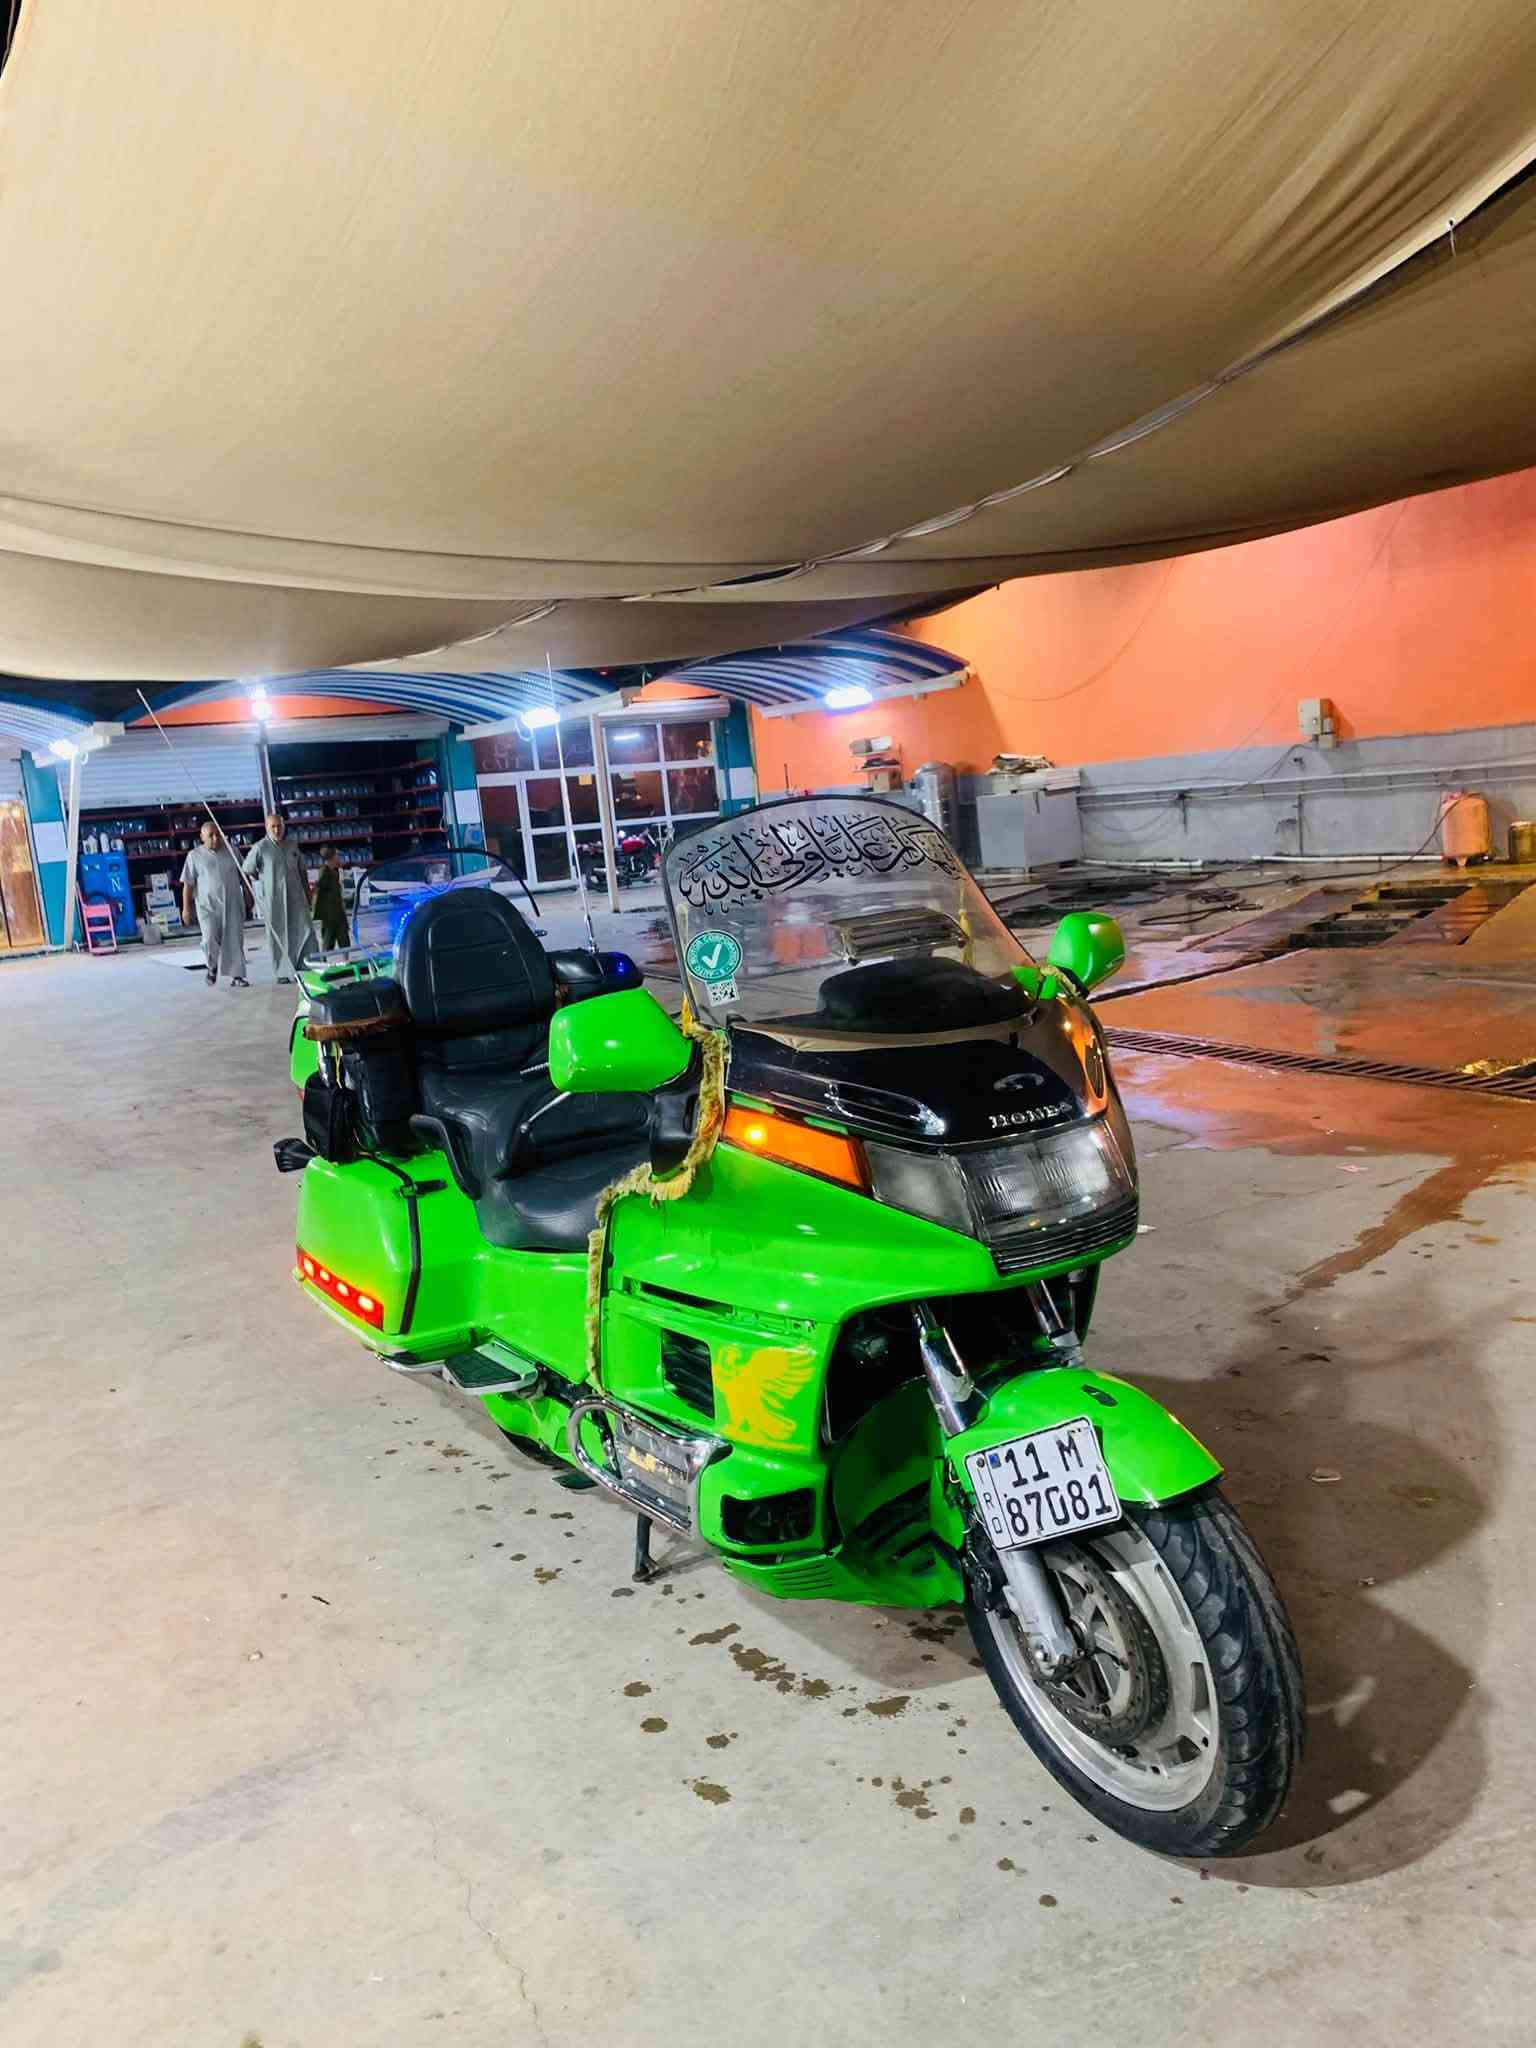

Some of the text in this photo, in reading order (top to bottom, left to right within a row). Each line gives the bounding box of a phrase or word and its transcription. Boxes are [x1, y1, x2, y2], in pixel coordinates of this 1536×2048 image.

[1004, 1430, 1085, 1489] 11 M
[1005, 1472, 1113, 1538] 87081
